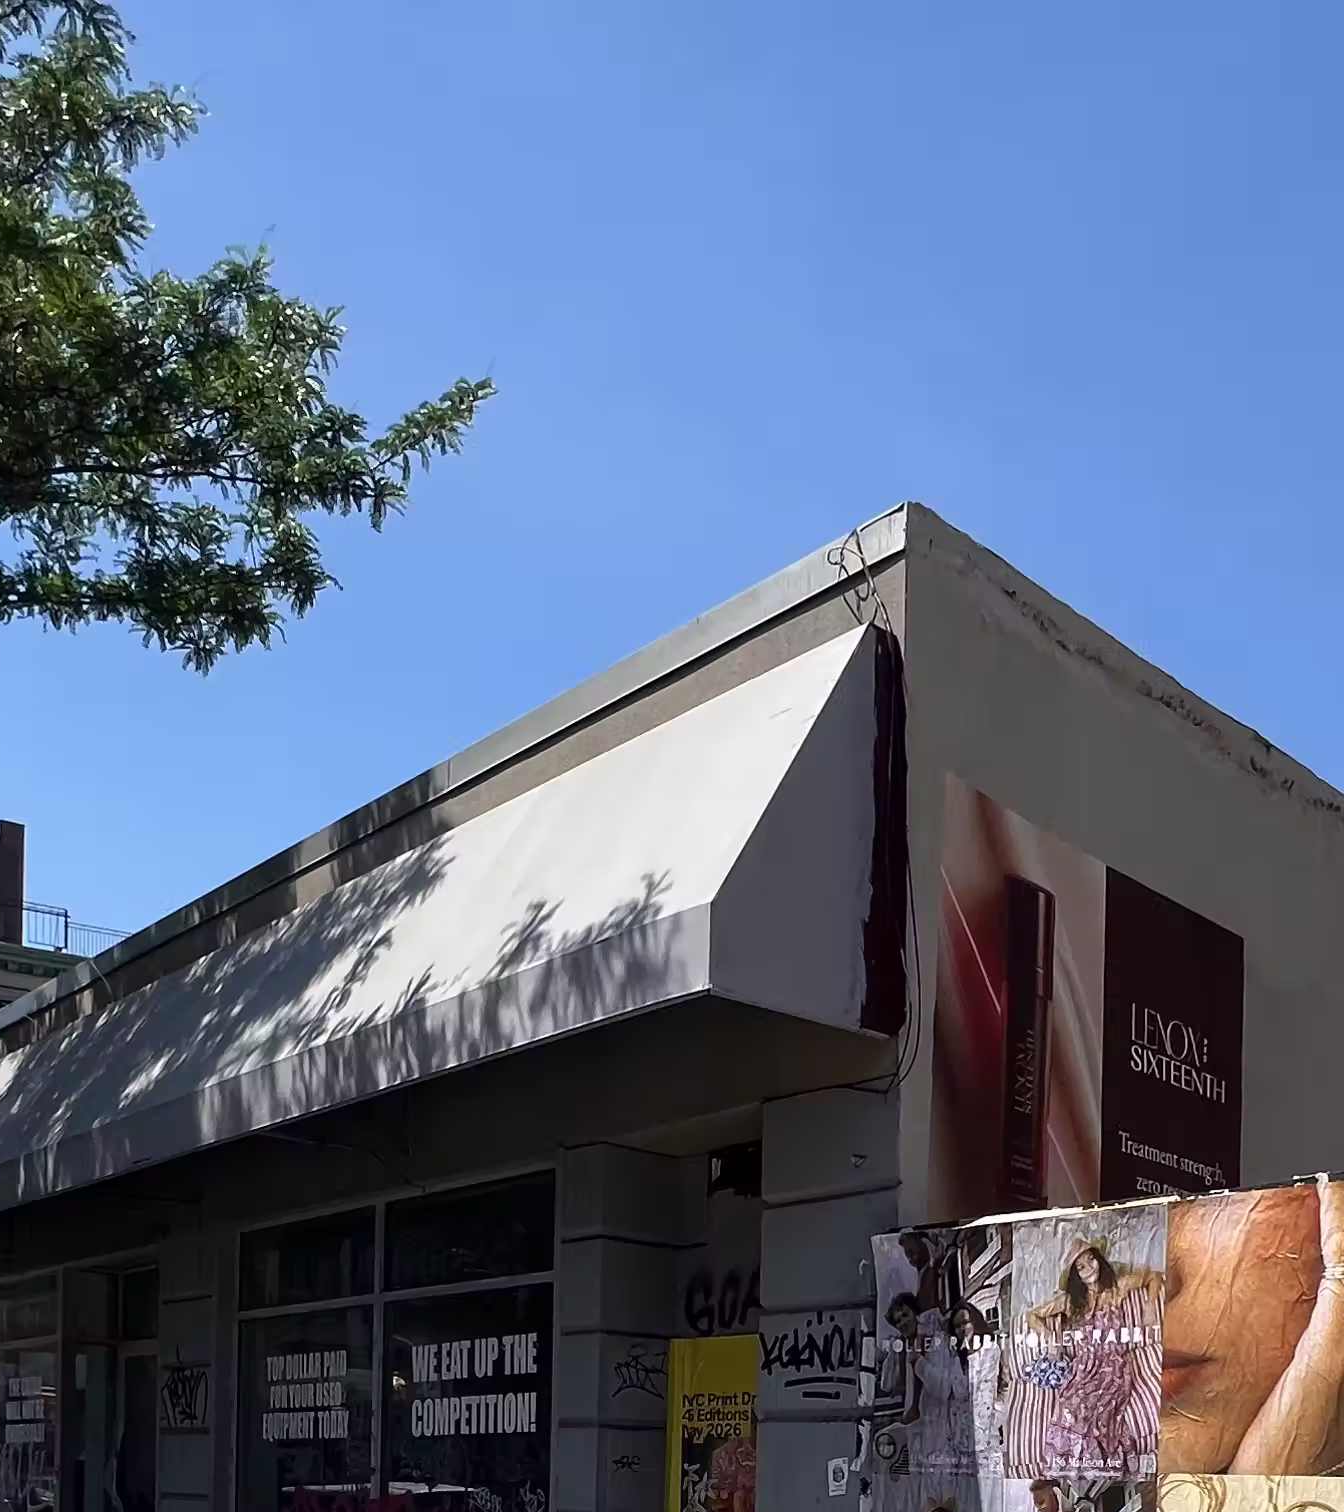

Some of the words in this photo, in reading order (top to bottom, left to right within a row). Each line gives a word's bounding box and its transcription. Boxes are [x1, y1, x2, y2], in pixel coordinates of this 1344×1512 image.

[1130, 1002, 1202, 1067] LENOX
[1129, 1045, 1226, 1104] SIXTEENTH
[1118, 1130, 1178, 1169] Treatment
[1136, 1176, 1162, 1195] zero
[881, 1336, 942, 1353] ROLLER
[949, 1333, 1008, 1351] RABBIT
[1015, 1326, 1082, 1348] ROLLER
[1092, 1325, 1161, 1344] RABBIT
[266, 1355, 285, 1382] TOP
[285, 1351, 322, 1380] DOLLAR
[323, 1349, 347, 1377] PAID
[411, 1344, 438, 1384] WE
[441, 1339, 471, 1381] EAT
[474, 1336, 499, 1378] UP
[503, 1332, 538, 1375] THE
[270, 1385, 287, 1409] FOR
[288, 1383, 315, 1409] YOUR
[707, 1392, 739, 1408] Print
[262, 1411, 315, 1442] EQUIPMENT
[317, 1409, 350, 1440] TODAY
[411, 1392, 538, 1438] COMPETITION!
[696, 1406, 749, 1422] Editions
[706, 1423, 742, 1438] 2026
